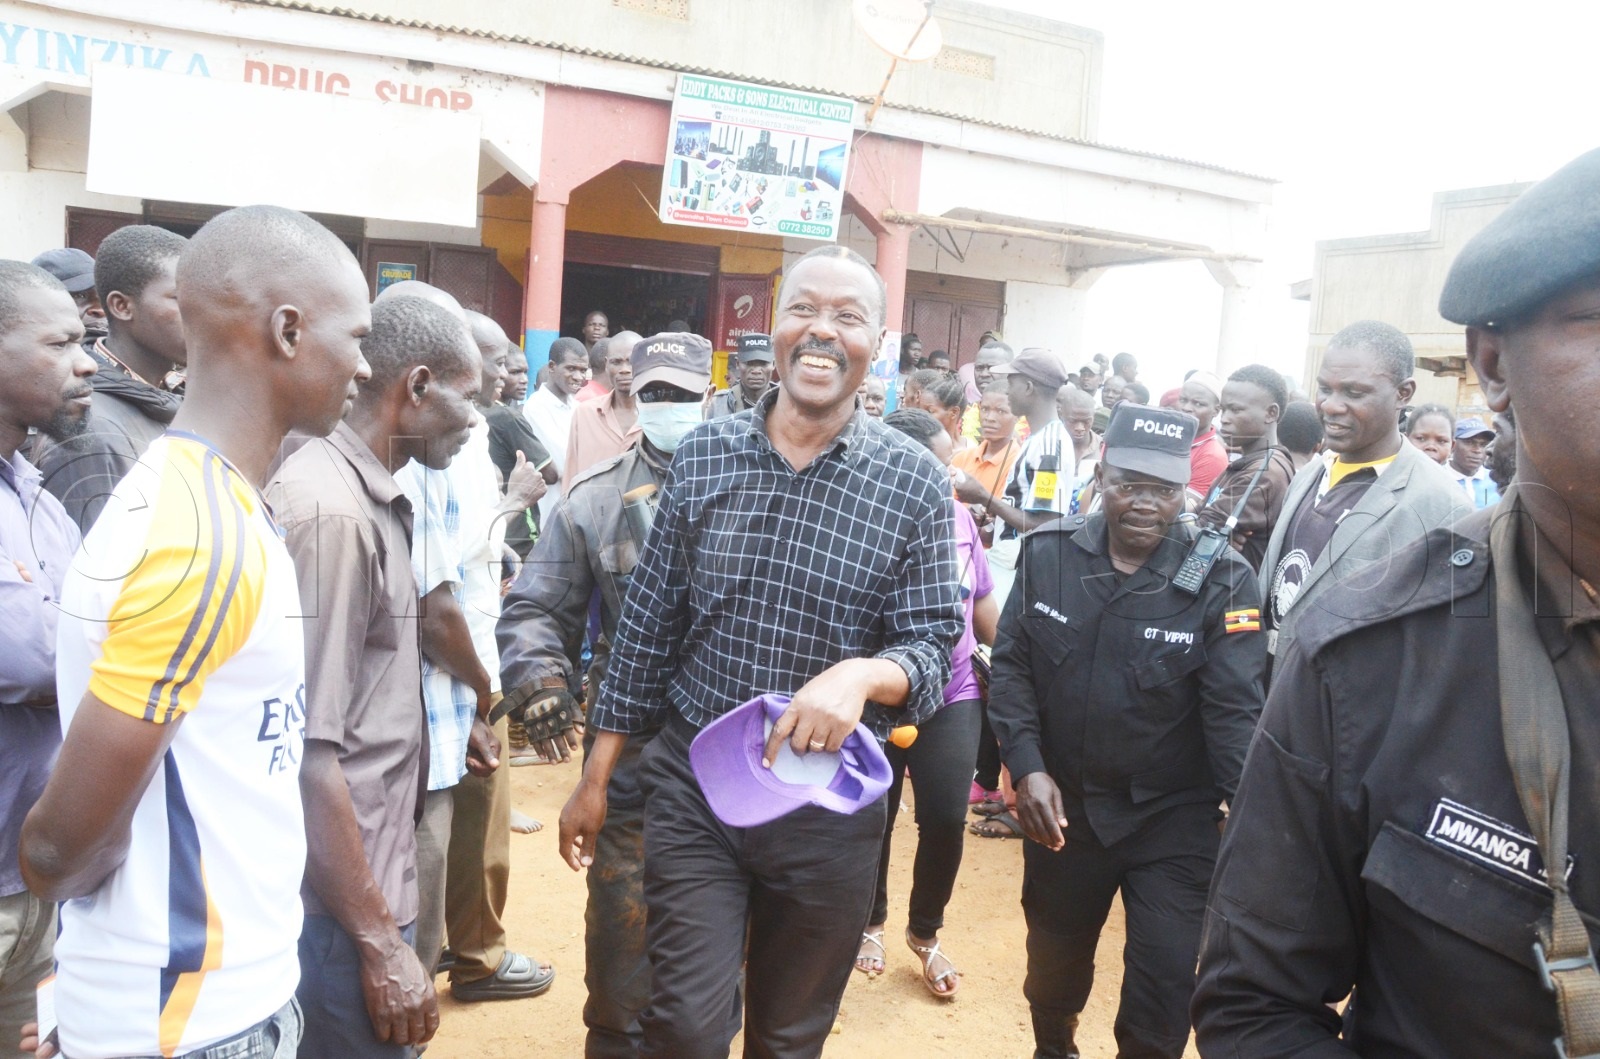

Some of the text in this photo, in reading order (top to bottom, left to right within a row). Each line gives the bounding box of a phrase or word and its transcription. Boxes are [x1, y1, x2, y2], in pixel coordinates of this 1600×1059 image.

[682, 79, 851, 121] EDDY PACKS & SONS ELECTRICAL CENTER
[760, 111, 793, 121] Electrical
[794, 116, 822, 125] Gadgets
[706, 215, 723, 223] Town
[723, 217, 748, 226] Council
[780, 222, 831, 236] 0772 382501
[381, 269, 412, 279] CRUSADE
[646, 341, 686, 356] POLICE
[745, 339, 768, 347] POLICE
[1133, 418, 1184, 440] POLICE
[1144, 627, 1194, 644] CT VIPPU
[1436, 815, 1532, 871] MWANGA
